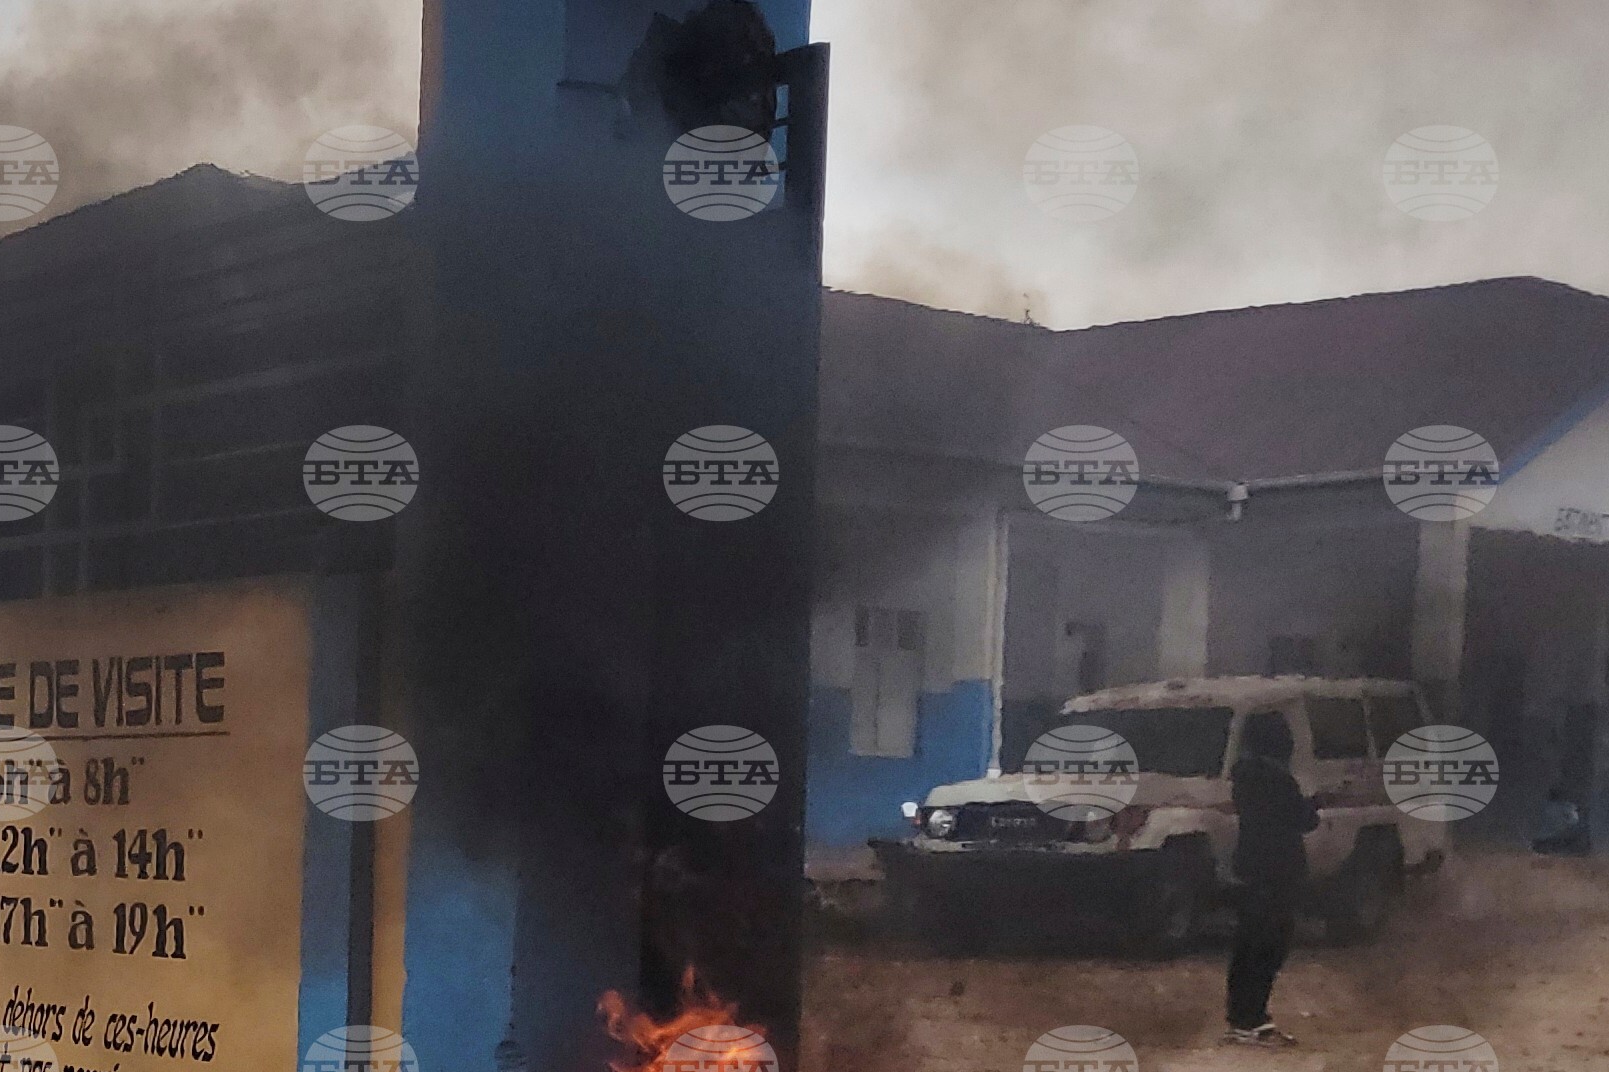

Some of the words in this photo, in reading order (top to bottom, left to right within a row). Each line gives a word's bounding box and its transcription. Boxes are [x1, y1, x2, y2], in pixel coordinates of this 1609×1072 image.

[28, 659, 81, 730] DE
[92, 651, 226, 727] VISITE
[50, 761, 71, 804] à
[71, 828, 97, 878] à
[68, 900, 95, 951] à
[2, 987, 66, 1043] dehors
[72, 995, 95, 1047] de
[103, 1003, 219, 1062] ces-heures
